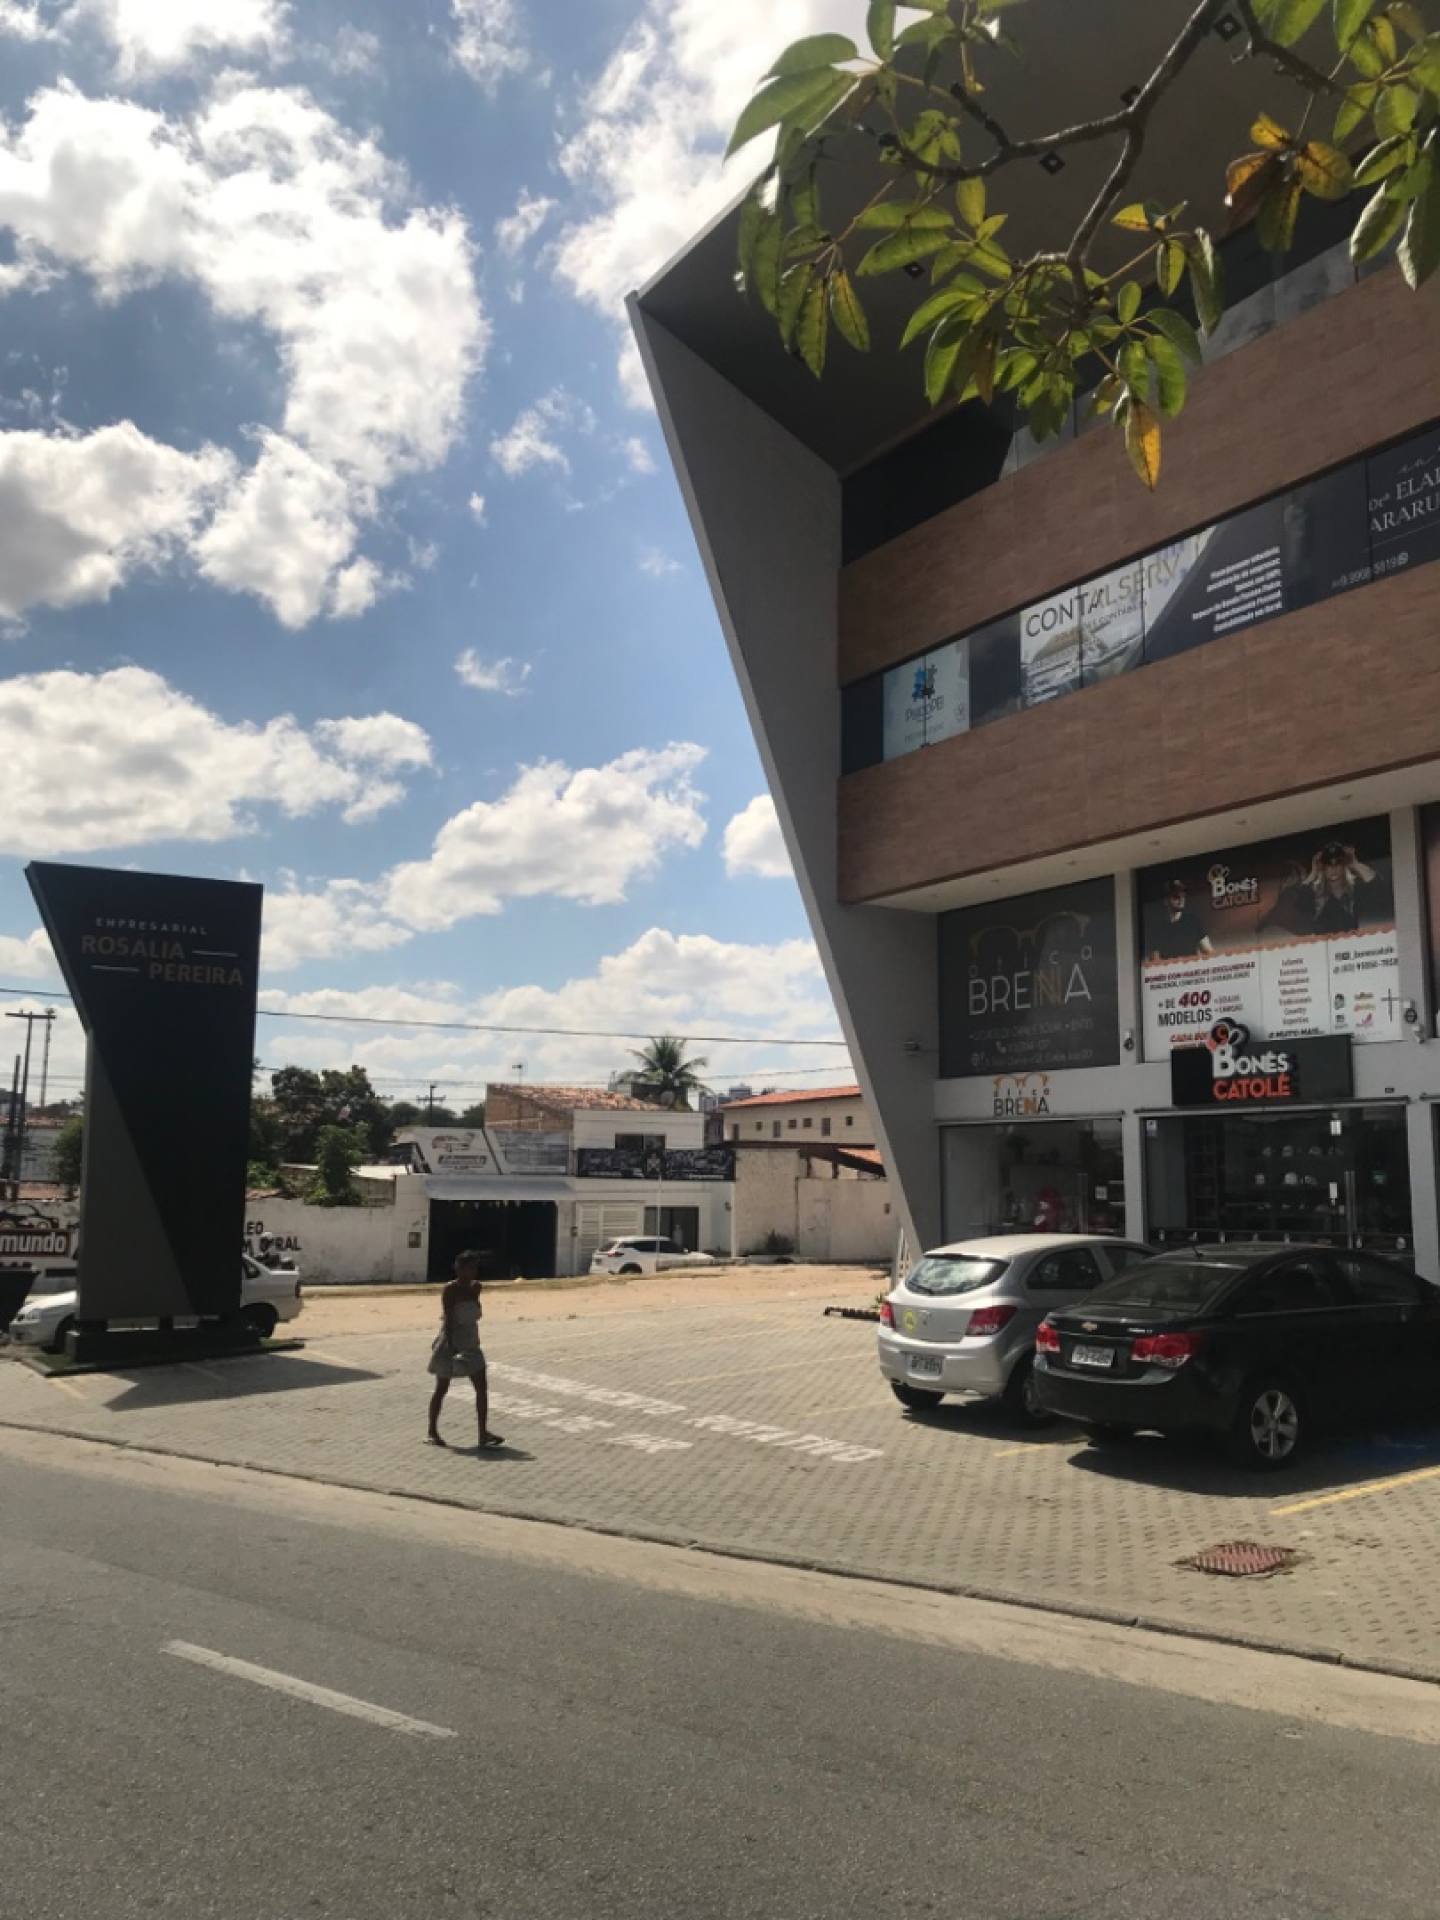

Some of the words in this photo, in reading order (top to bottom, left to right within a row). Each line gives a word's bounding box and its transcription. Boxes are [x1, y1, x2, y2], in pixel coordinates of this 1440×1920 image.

[95, 916, 208, 936] EMPRESARIAL
[148, 962, 243, 986] PEREIRA
[968, 962, 1093, 1016] BRENA
[1178, 989, 1212, 1007] 400
[1158, 1007, 1213, 1027] MODELOS
[1212, 1043, 1289, 1079] BONÉS
[1213, 1071, 1292, 1101] CATOLÉ
[993, 1096, 1050, 1117] BRENA
[244, 1221, 263, 1235] EO
